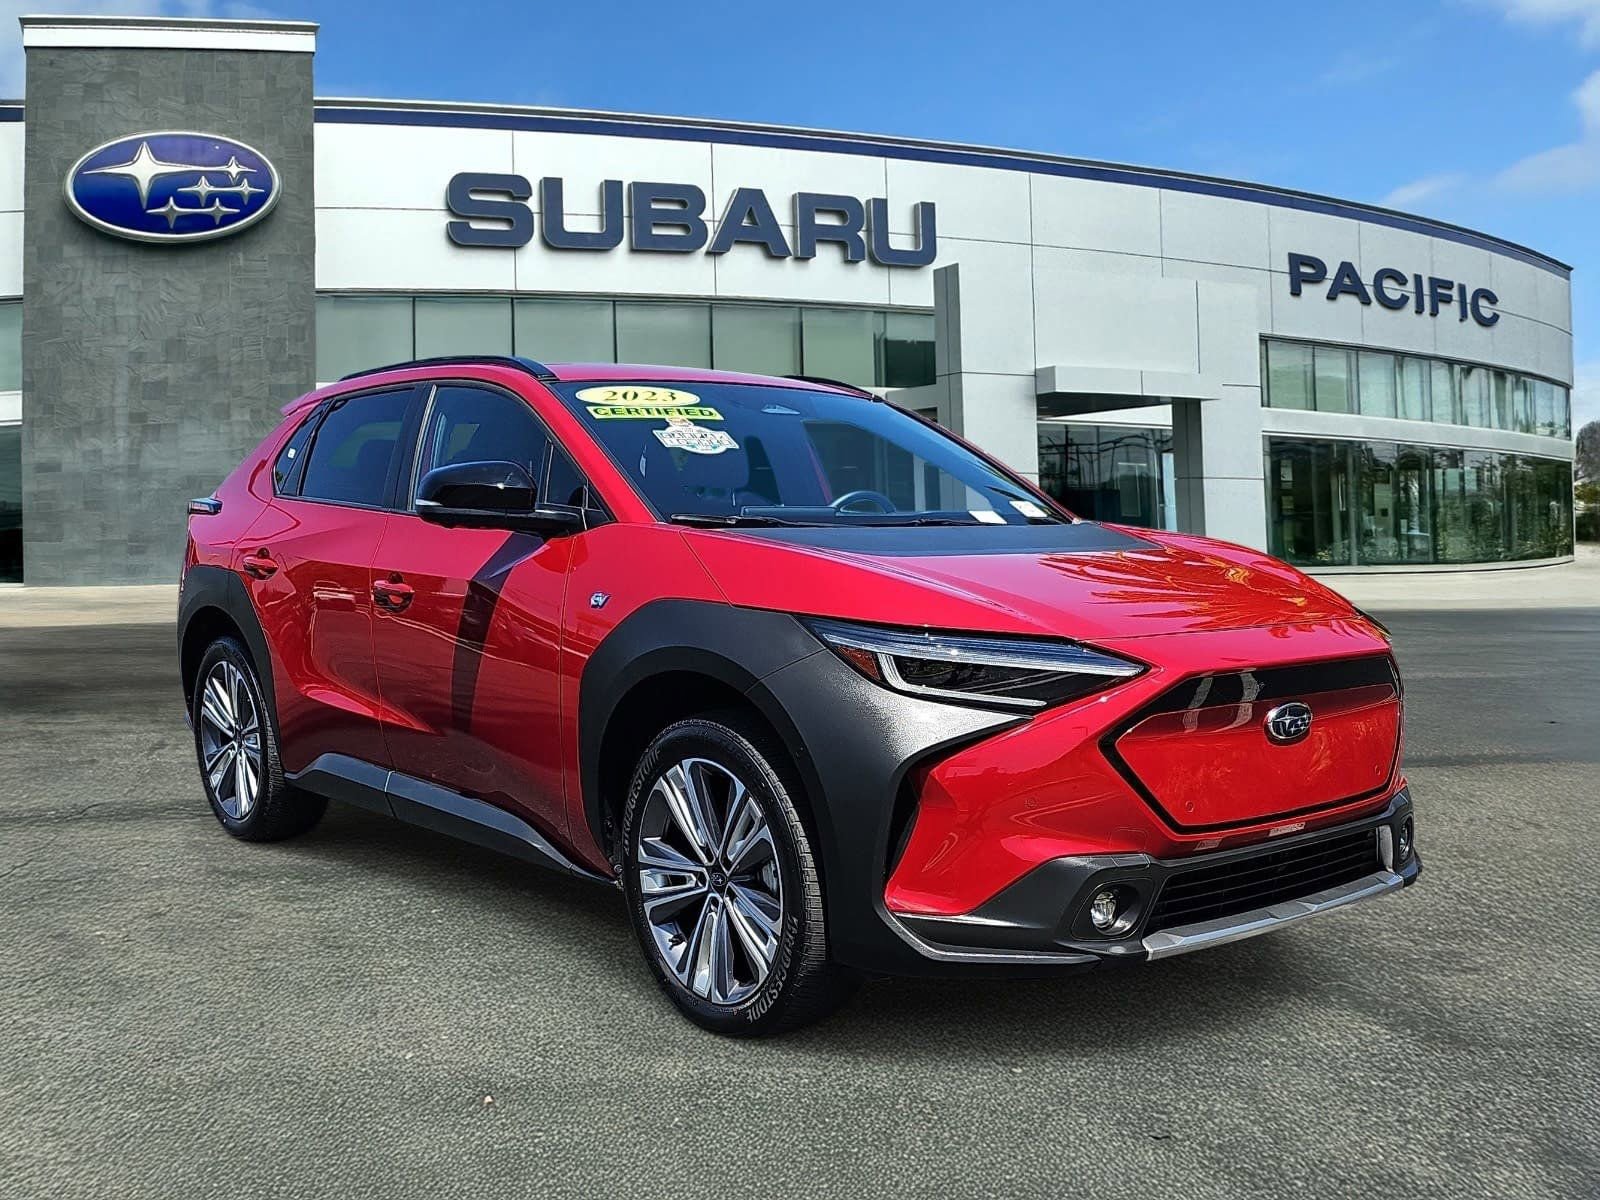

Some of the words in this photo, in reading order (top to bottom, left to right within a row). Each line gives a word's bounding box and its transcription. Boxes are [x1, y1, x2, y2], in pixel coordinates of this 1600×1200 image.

[446, 171, 937, 268] SUBARU
[1288, 252, 1500, 327] PACIFIC
[593, 407, 714, 417] CERTIFIED
[604, 390, 677, 402] 2023
